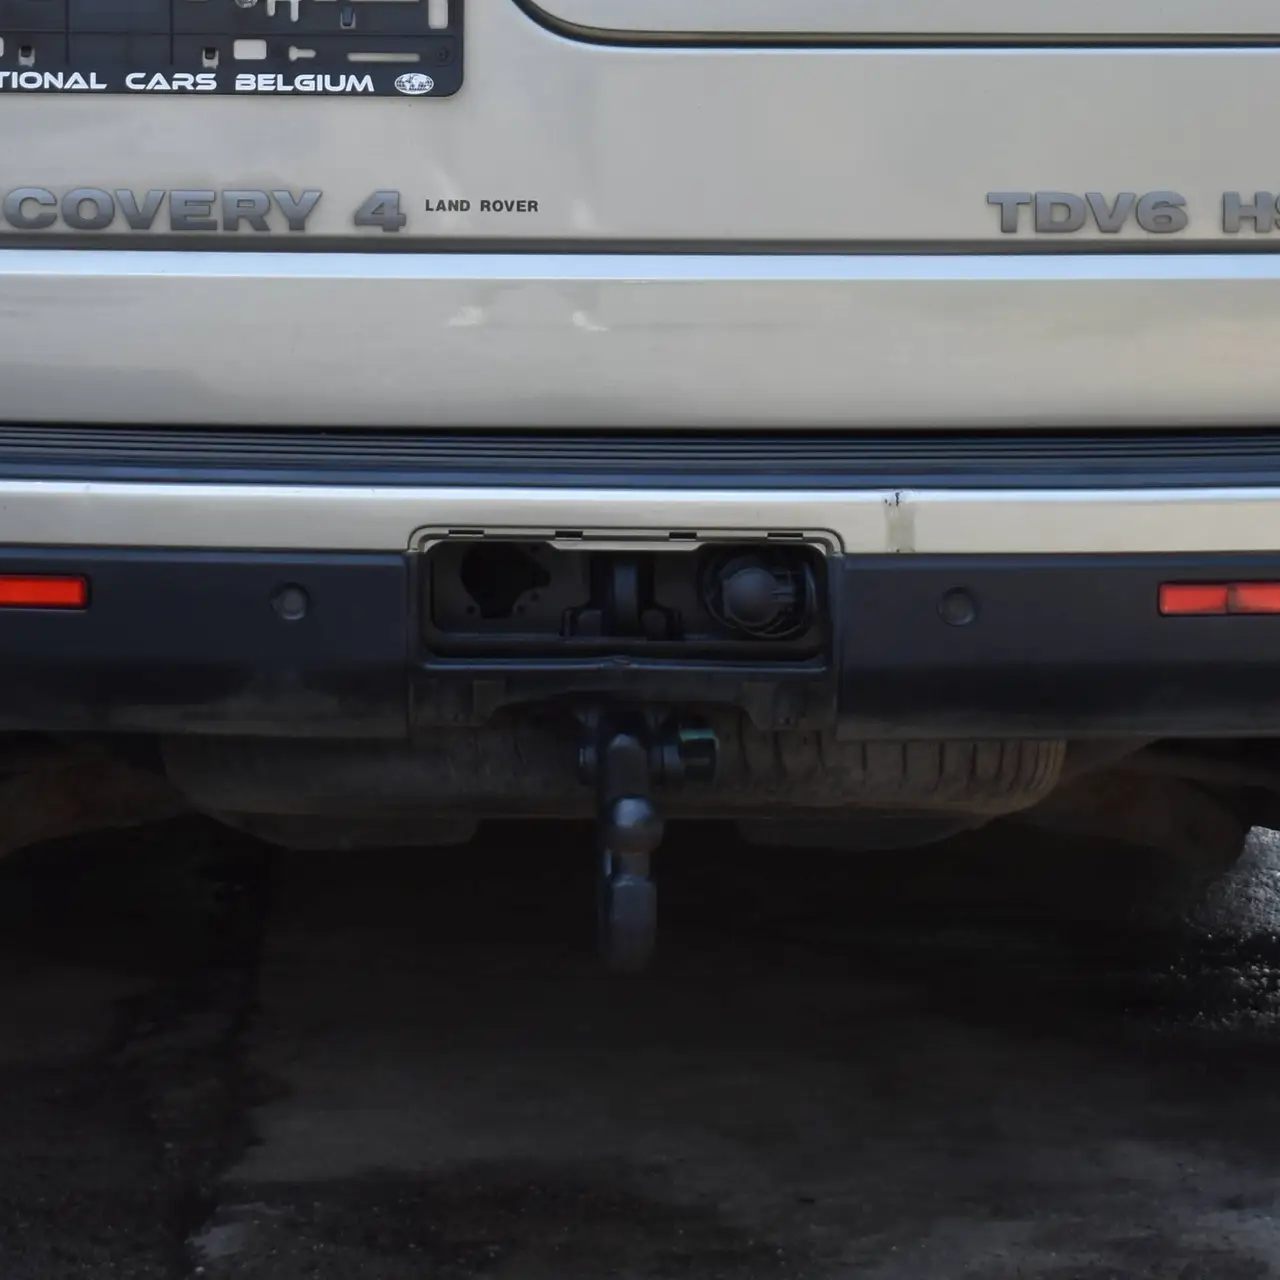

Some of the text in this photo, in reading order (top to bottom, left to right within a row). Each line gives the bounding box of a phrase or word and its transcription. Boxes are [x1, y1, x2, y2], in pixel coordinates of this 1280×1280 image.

[124, 71, 218, 91] CARS
[234, 72, 376, 93] BELGIUM
[352, 190, 408, 233] 4
[425, 199, 539, 213] LAND ROVER
[985, 190, 1189, 234] TDV6
